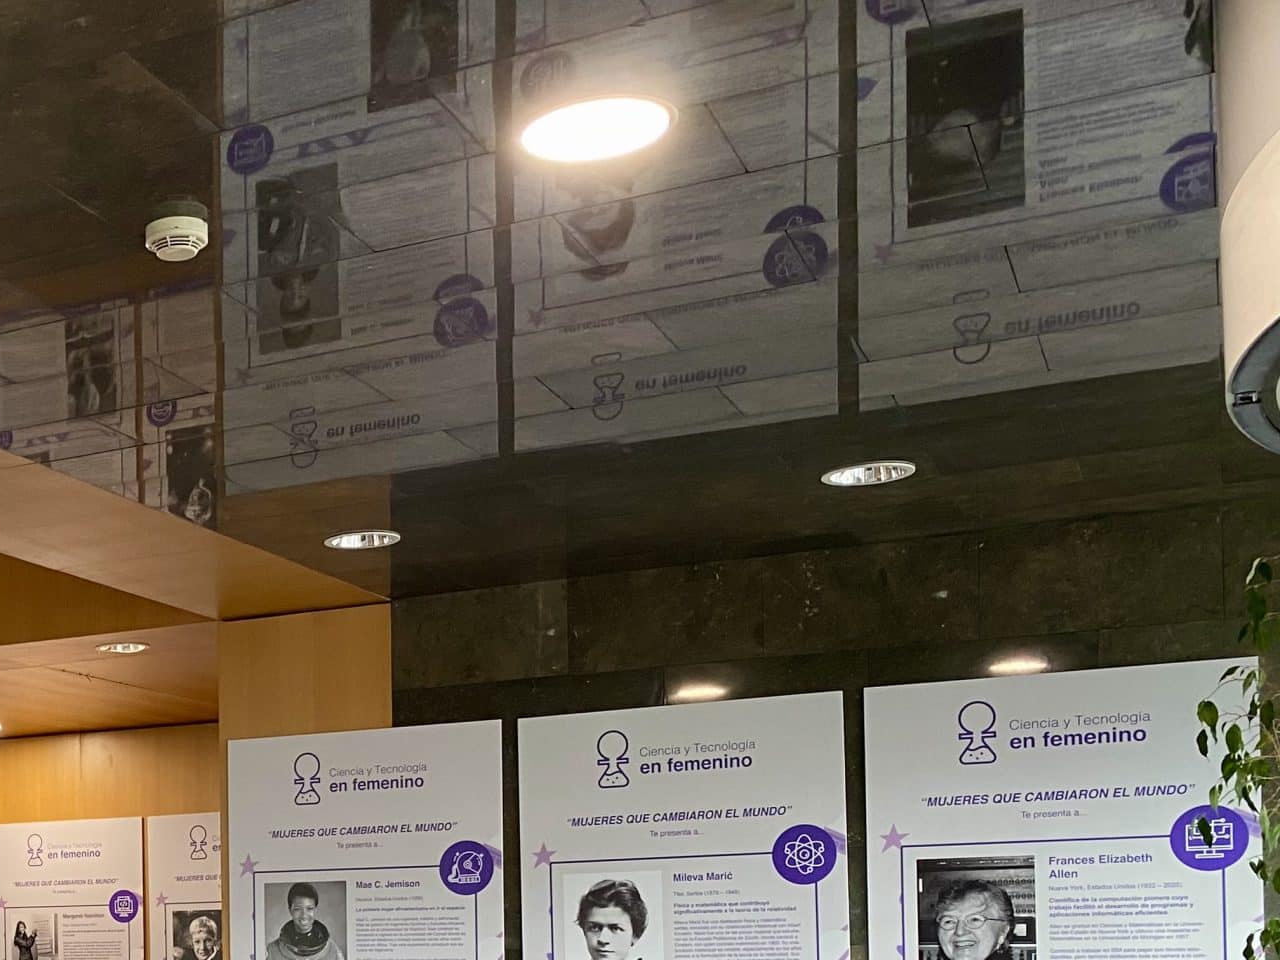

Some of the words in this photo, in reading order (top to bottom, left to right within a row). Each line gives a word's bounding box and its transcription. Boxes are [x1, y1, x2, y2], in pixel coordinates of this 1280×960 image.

[1009, 719, 1059, 731] Ciencia
[1063, 719, 1071, 729] y
[1075, 711, 1151, 727] Tecnología
[1009, 735, 1036, 750] en
[1042, 727, 1147, 748] femenino
[639, 746, 681, 758] Ciencia
[694, 739, 756, 754] Tecnología
[328, 767, 364, 778] Ciencia
[375, 763, 427, 776] Tecnología
[640, 761, 662, 775] en
[667, 753, 753, 772] femenino
[329, 781, 348, 793] en
[352, 775, 425, 791] femenino
[992, 792, 1022, 805] QUE
[1024, 787, 1109, 802] CAMBIARON
[1112, 786, 1130, 798] EL
[626, 813, 650, 826] QUE
[652, 809, 722, 823] CAMBIARON
[725, 807, 739, 819] EL
[1021, 810, 1032, 819] Te
[1033, 810, 1071, 820] presenta
[317, 826, 338, 838] QUE
[339, 824, 398, 837] CAMBIARON
[400, 822, 414, 834] EL
[650, 830, 659, 838] Te
[660, 829, 691, 838] presenta
[47, 852, 58, 860] en
[61, 849, 101, 859] femenino
[1048, 855, 1095, 866] Frances
[1098, 853, 1153, 864] Elizabeth
[673, 872, 704, 882] Mileva
[1049, 868, 1078, 878] Allen
[355, 881, 372, 889] Mae
[374, 880, 383, 889] C.
[384, 879, 420, 888] Jemison
